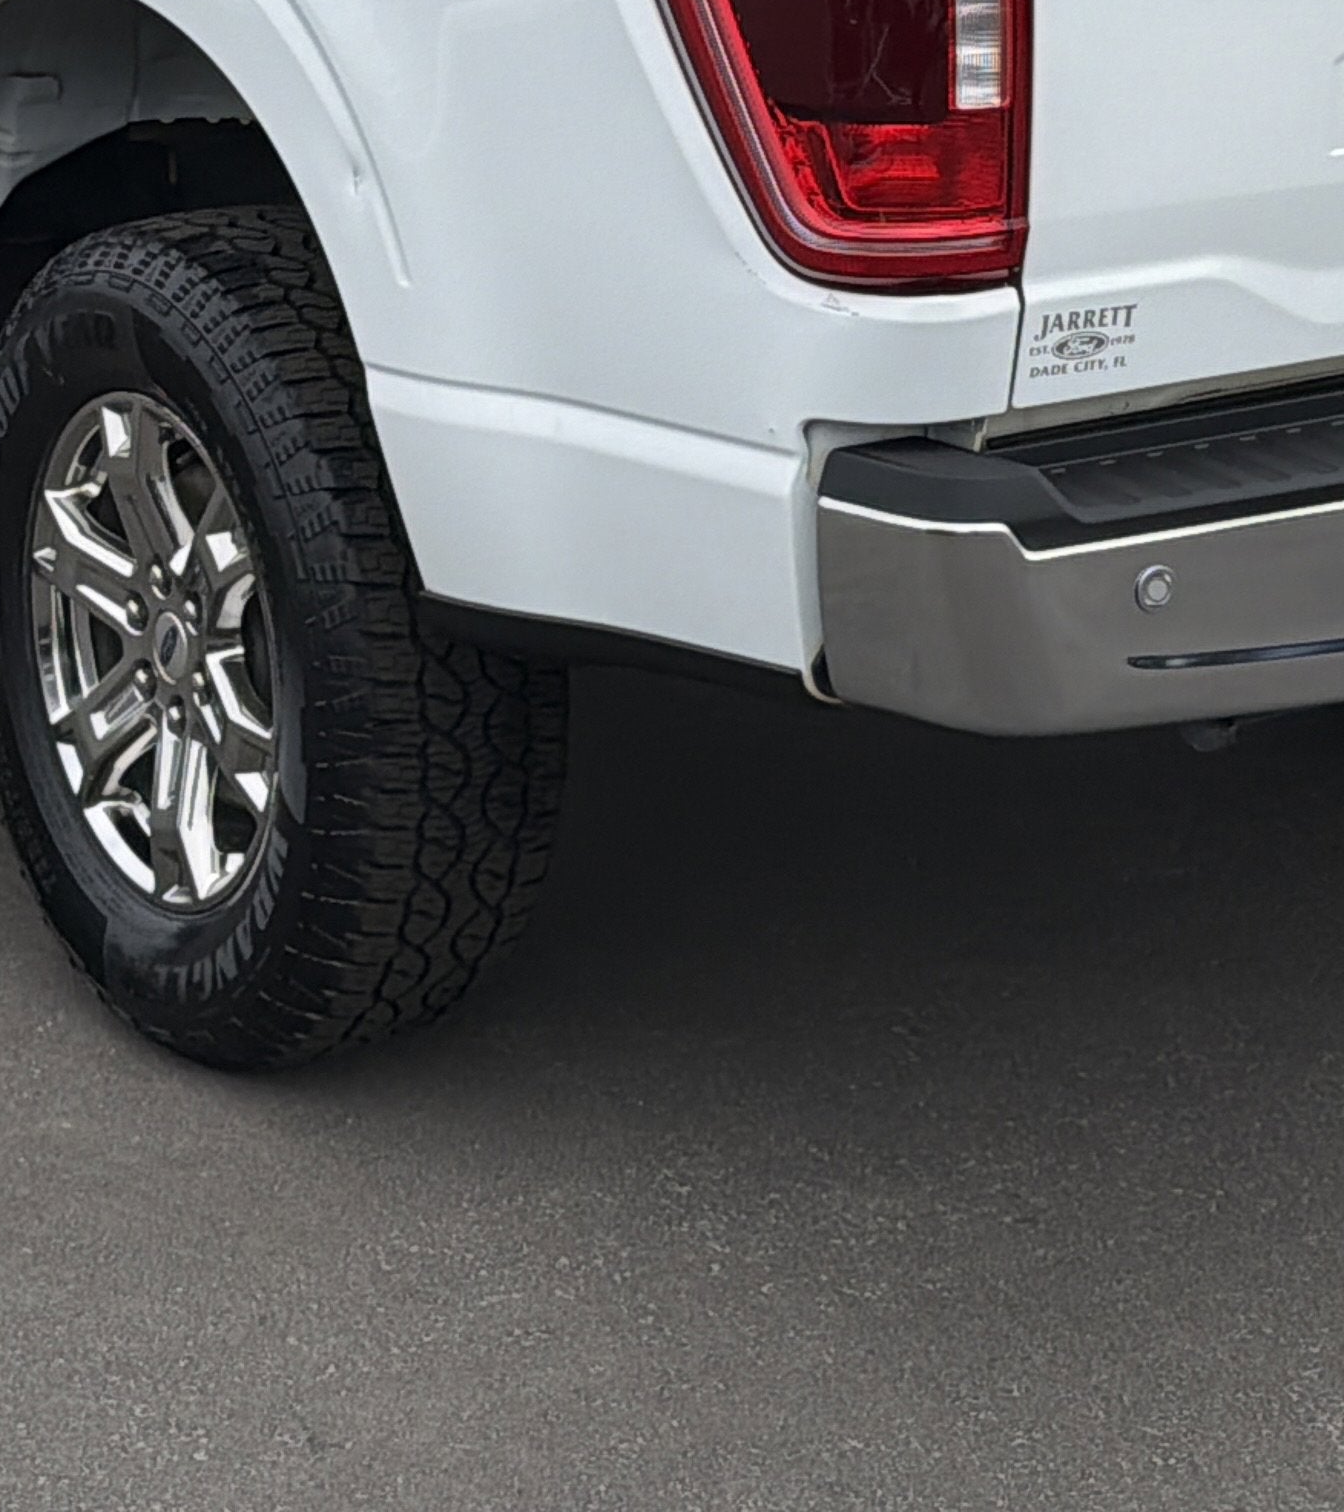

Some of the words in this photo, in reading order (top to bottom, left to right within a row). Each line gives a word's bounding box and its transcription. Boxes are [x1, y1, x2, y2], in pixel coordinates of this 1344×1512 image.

[1033, 303, 1138, 342] JARRETT
[1029, 363, 1068, 378] DADE
[1112, 355, 1127, 368] FL
